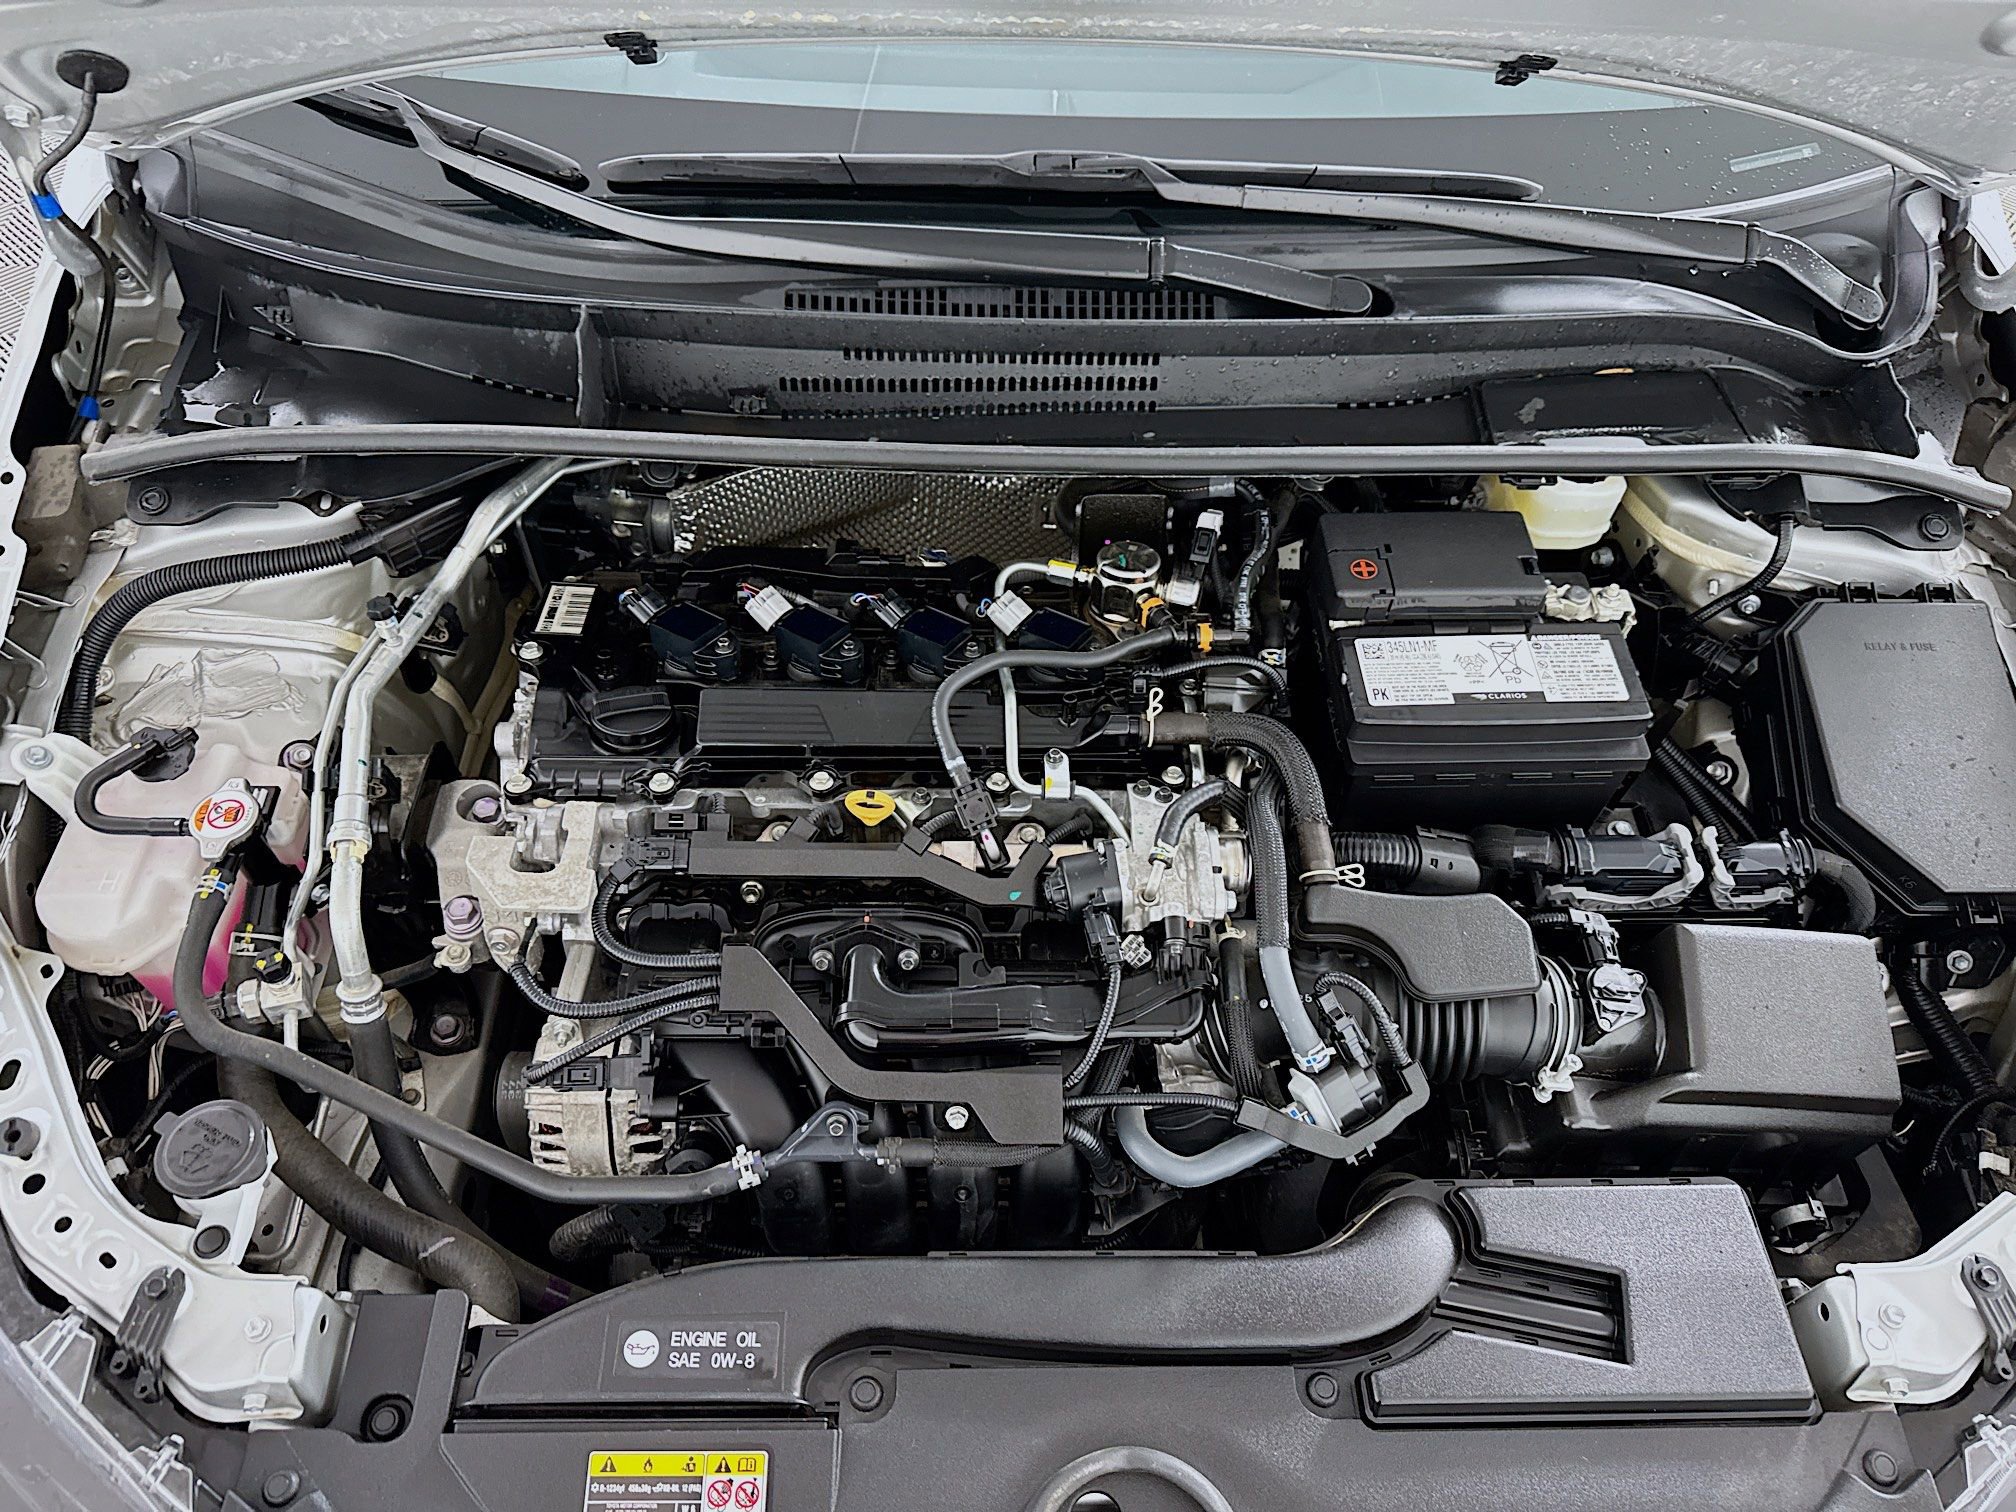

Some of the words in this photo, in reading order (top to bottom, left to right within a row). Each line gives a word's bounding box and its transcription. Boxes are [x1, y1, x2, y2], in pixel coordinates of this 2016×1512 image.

[1864, 642, 1897, 651] RELAY
[1900, 642, 1908, 651] &
[1909, 642, 1938, 652] FUSE
[1505, 675, 1521, 684] Pb
[1372, 688, 1390, 701] PK
[1488, 692, 1528, 700] CLARIOS
[670, 1331, 727, 1348] ENGINE
[736, 1331, 761, 1348] OIL
[668, 1352, 700, 1369] SAE
[711, 1352, 755, 1369] 0W-8
